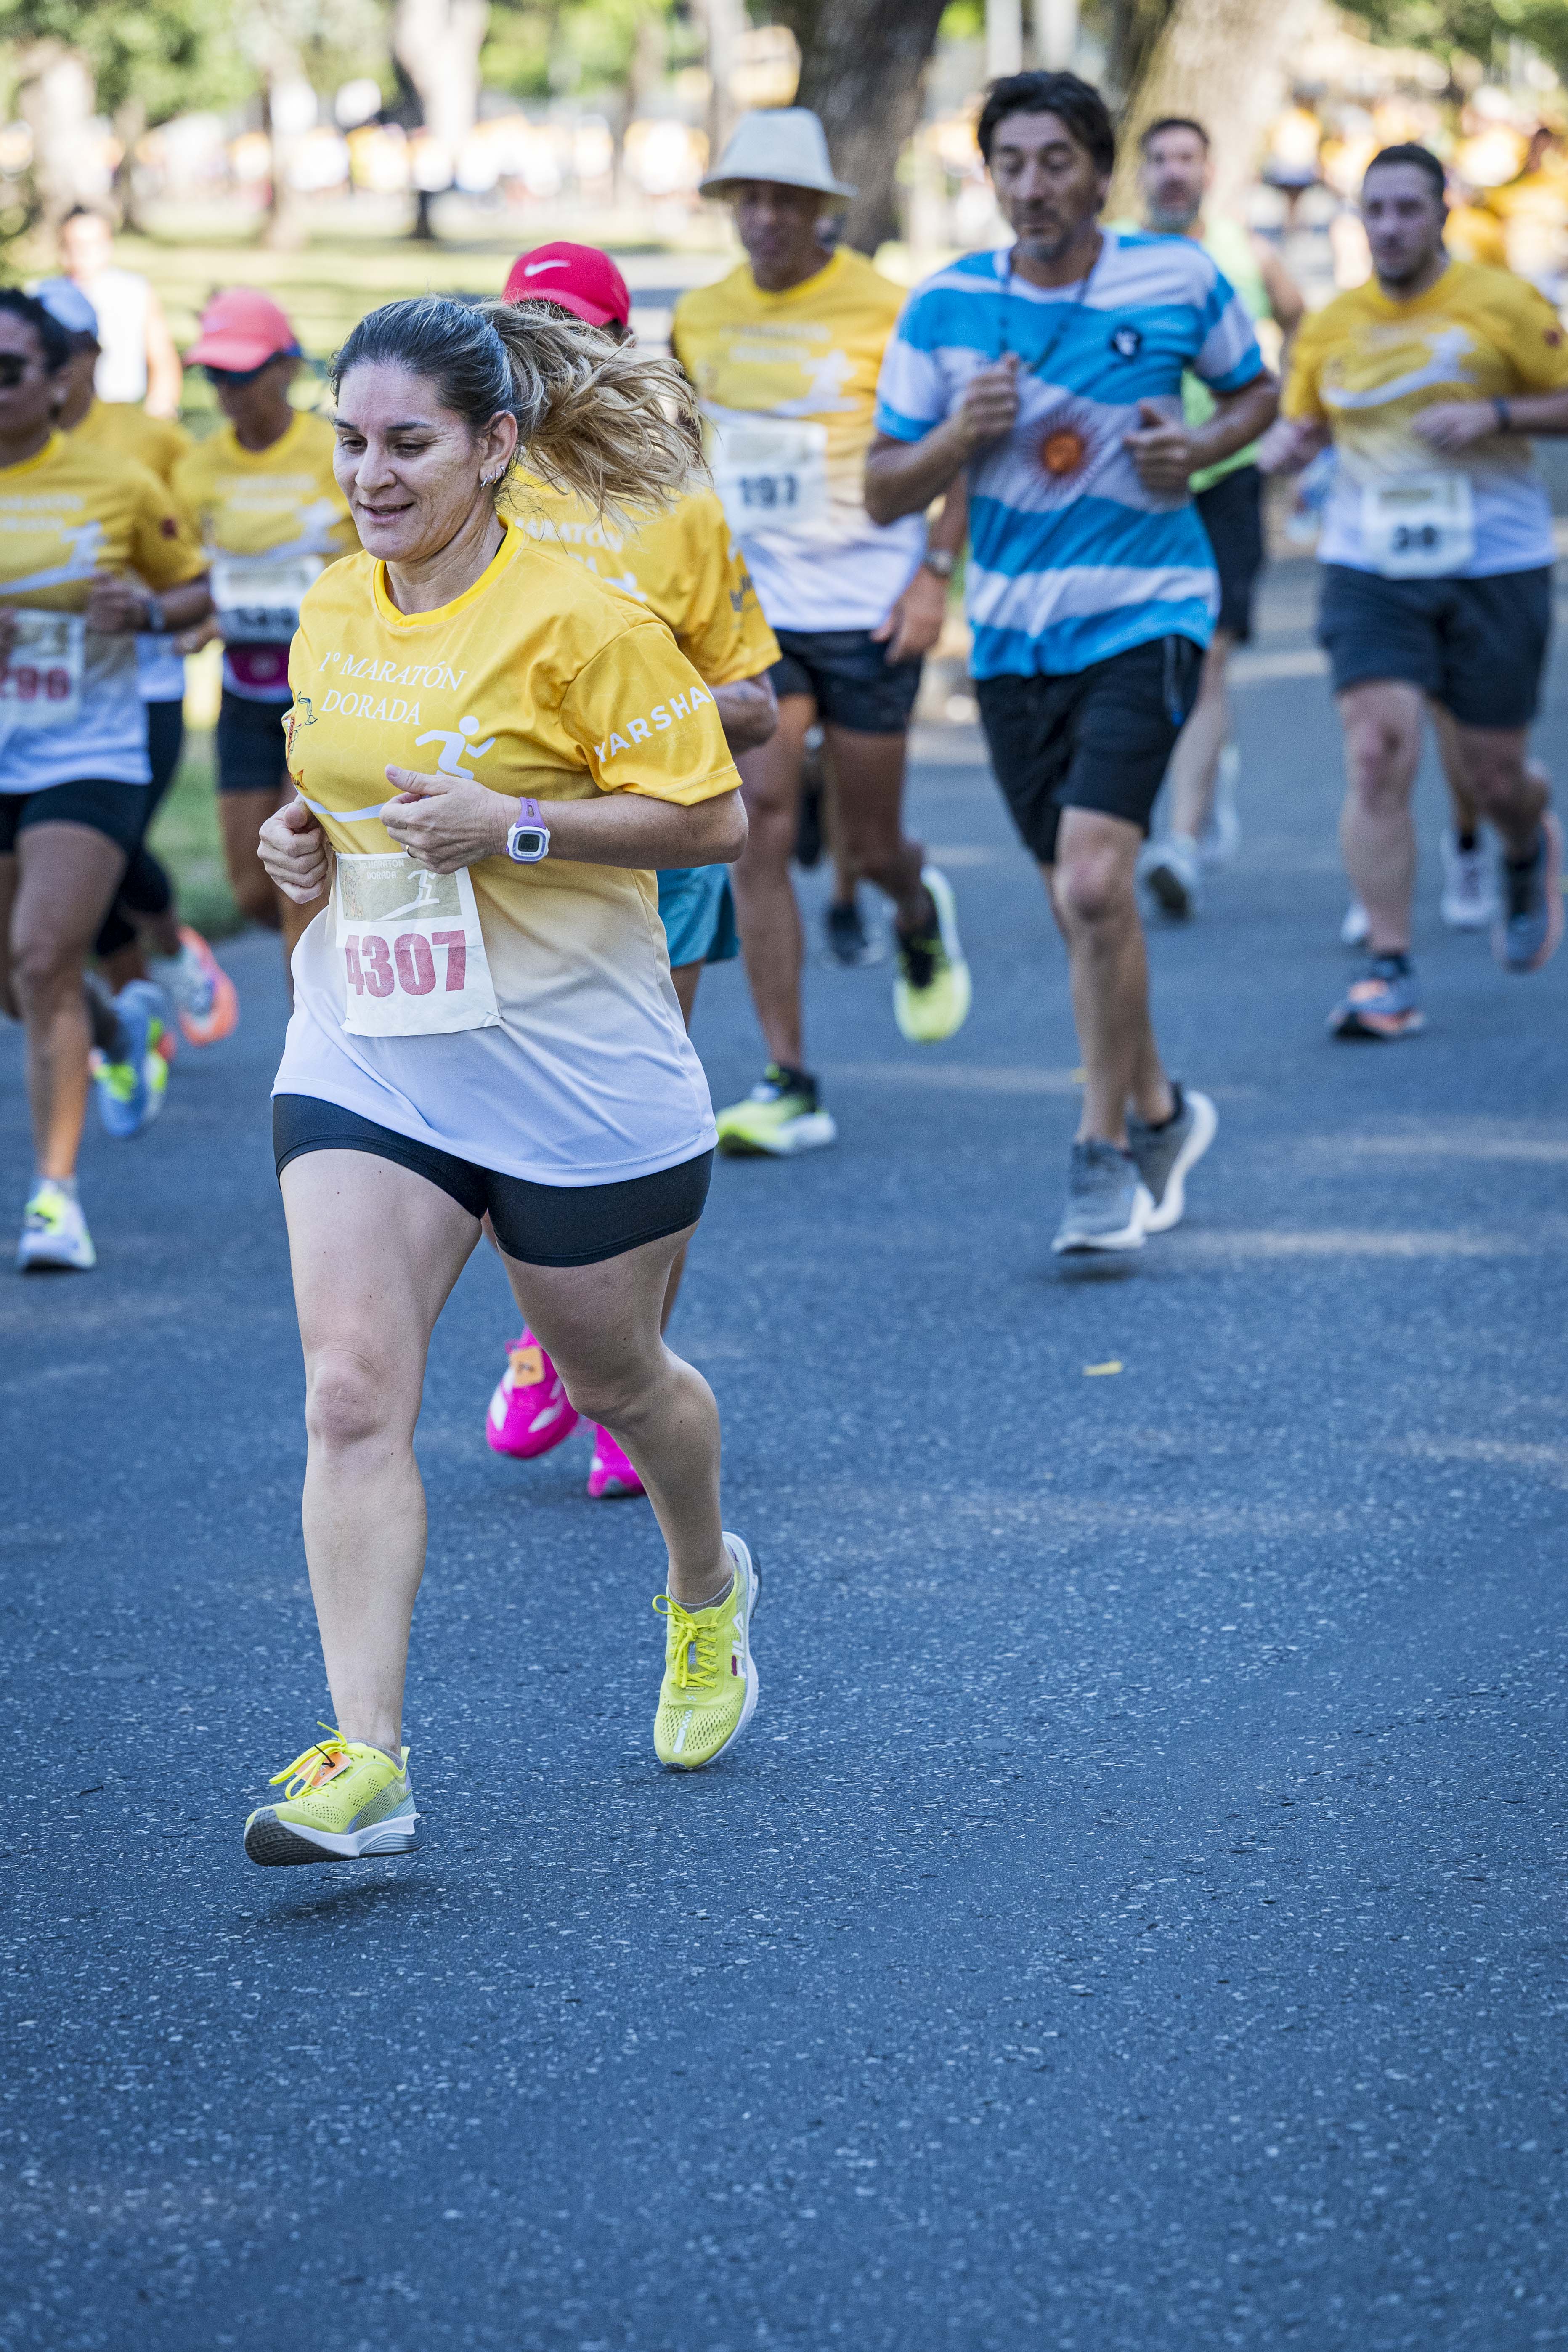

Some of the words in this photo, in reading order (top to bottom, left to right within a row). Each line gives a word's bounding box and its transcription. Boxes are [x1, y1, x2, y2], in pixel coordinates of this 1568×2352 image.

[340, 654, 468, 691] MARATÓN
[319, 689, 421, 725] DORADA
[594, 681, 715, 763] YARSHA
[367, 871, 397, 880] DORADA
[345, 930, 466, 998] 4307
